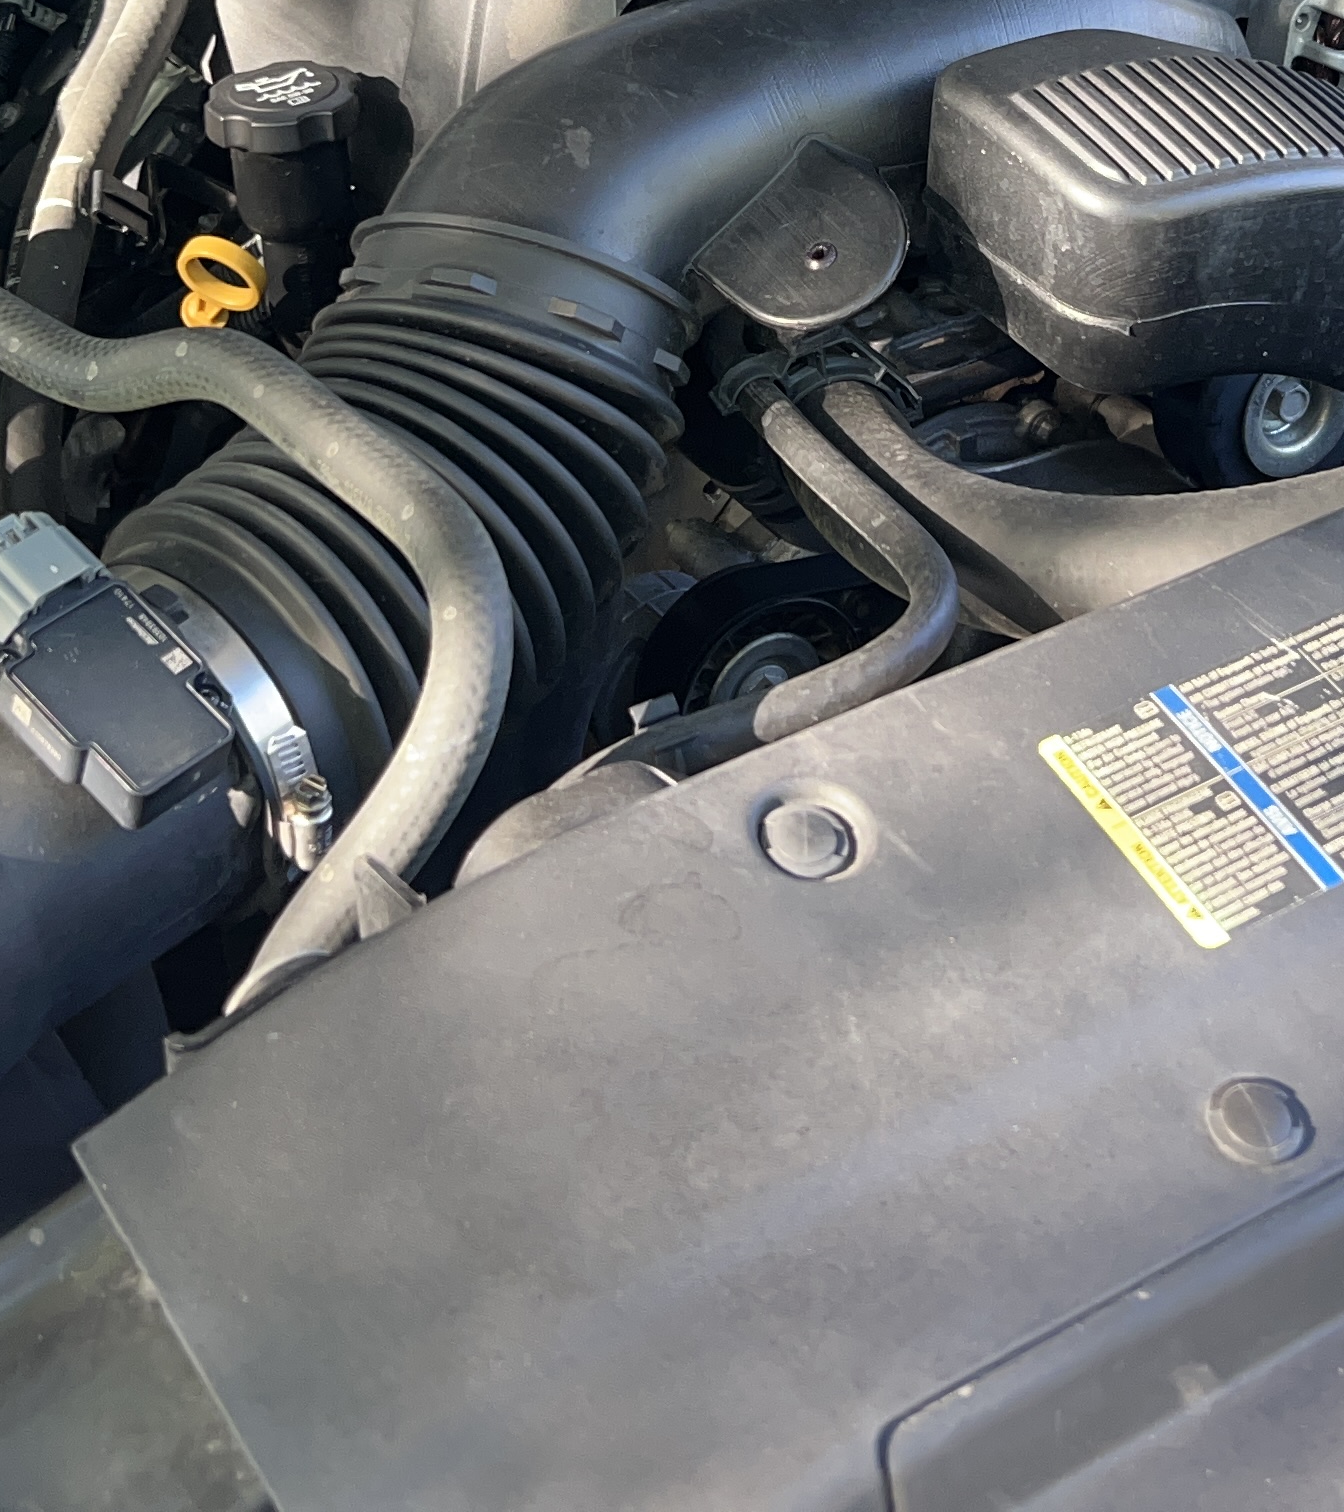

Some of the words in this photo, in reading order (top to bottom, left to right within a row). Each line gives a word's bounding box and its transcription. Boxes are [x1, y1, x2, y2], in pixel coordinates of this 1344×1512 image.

[1174, 706, 1223, 754] NOTICE
[1051, 747, 1103, 800] CAUTION
[1260, 802, 1300, 839] AVIS
